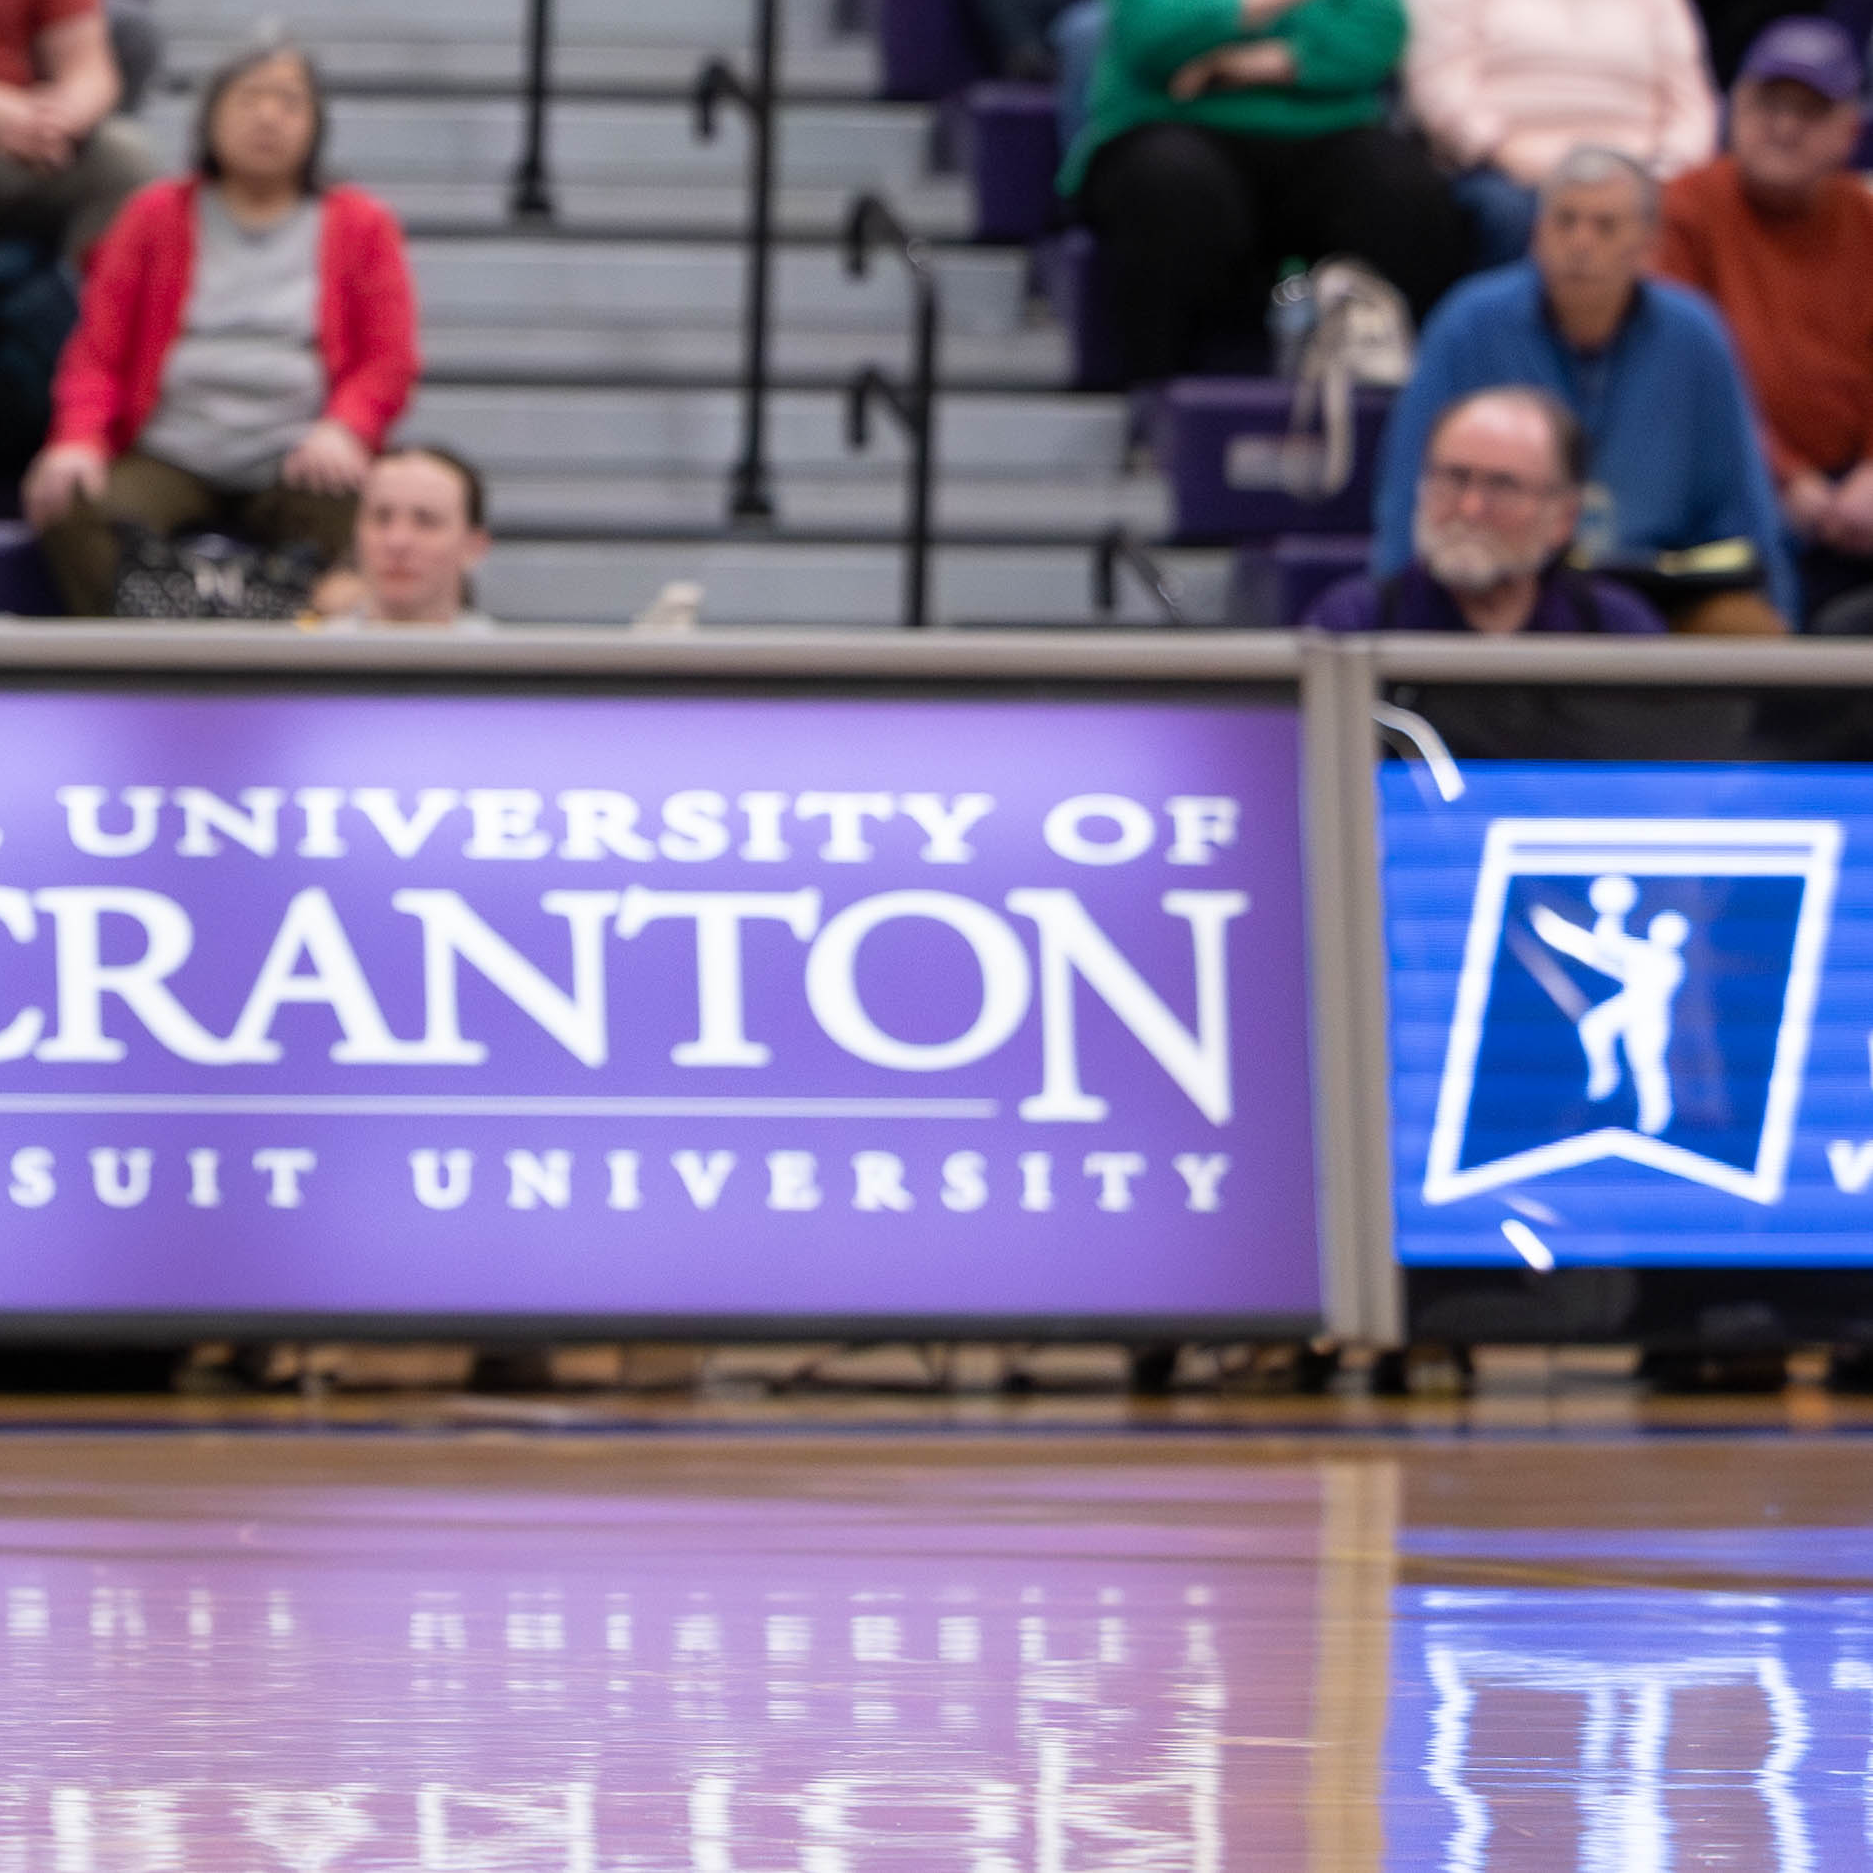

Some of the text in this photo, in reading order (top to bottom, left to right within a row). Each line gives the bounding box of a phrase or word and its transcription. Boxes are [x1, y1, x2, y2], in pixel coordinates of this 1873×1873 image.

[56, 784, 997, 864] UNIVERSITY
[1042, 792, 1242, 867] OF
[408, 1147, 1233, 1213] UNIVERSITY
